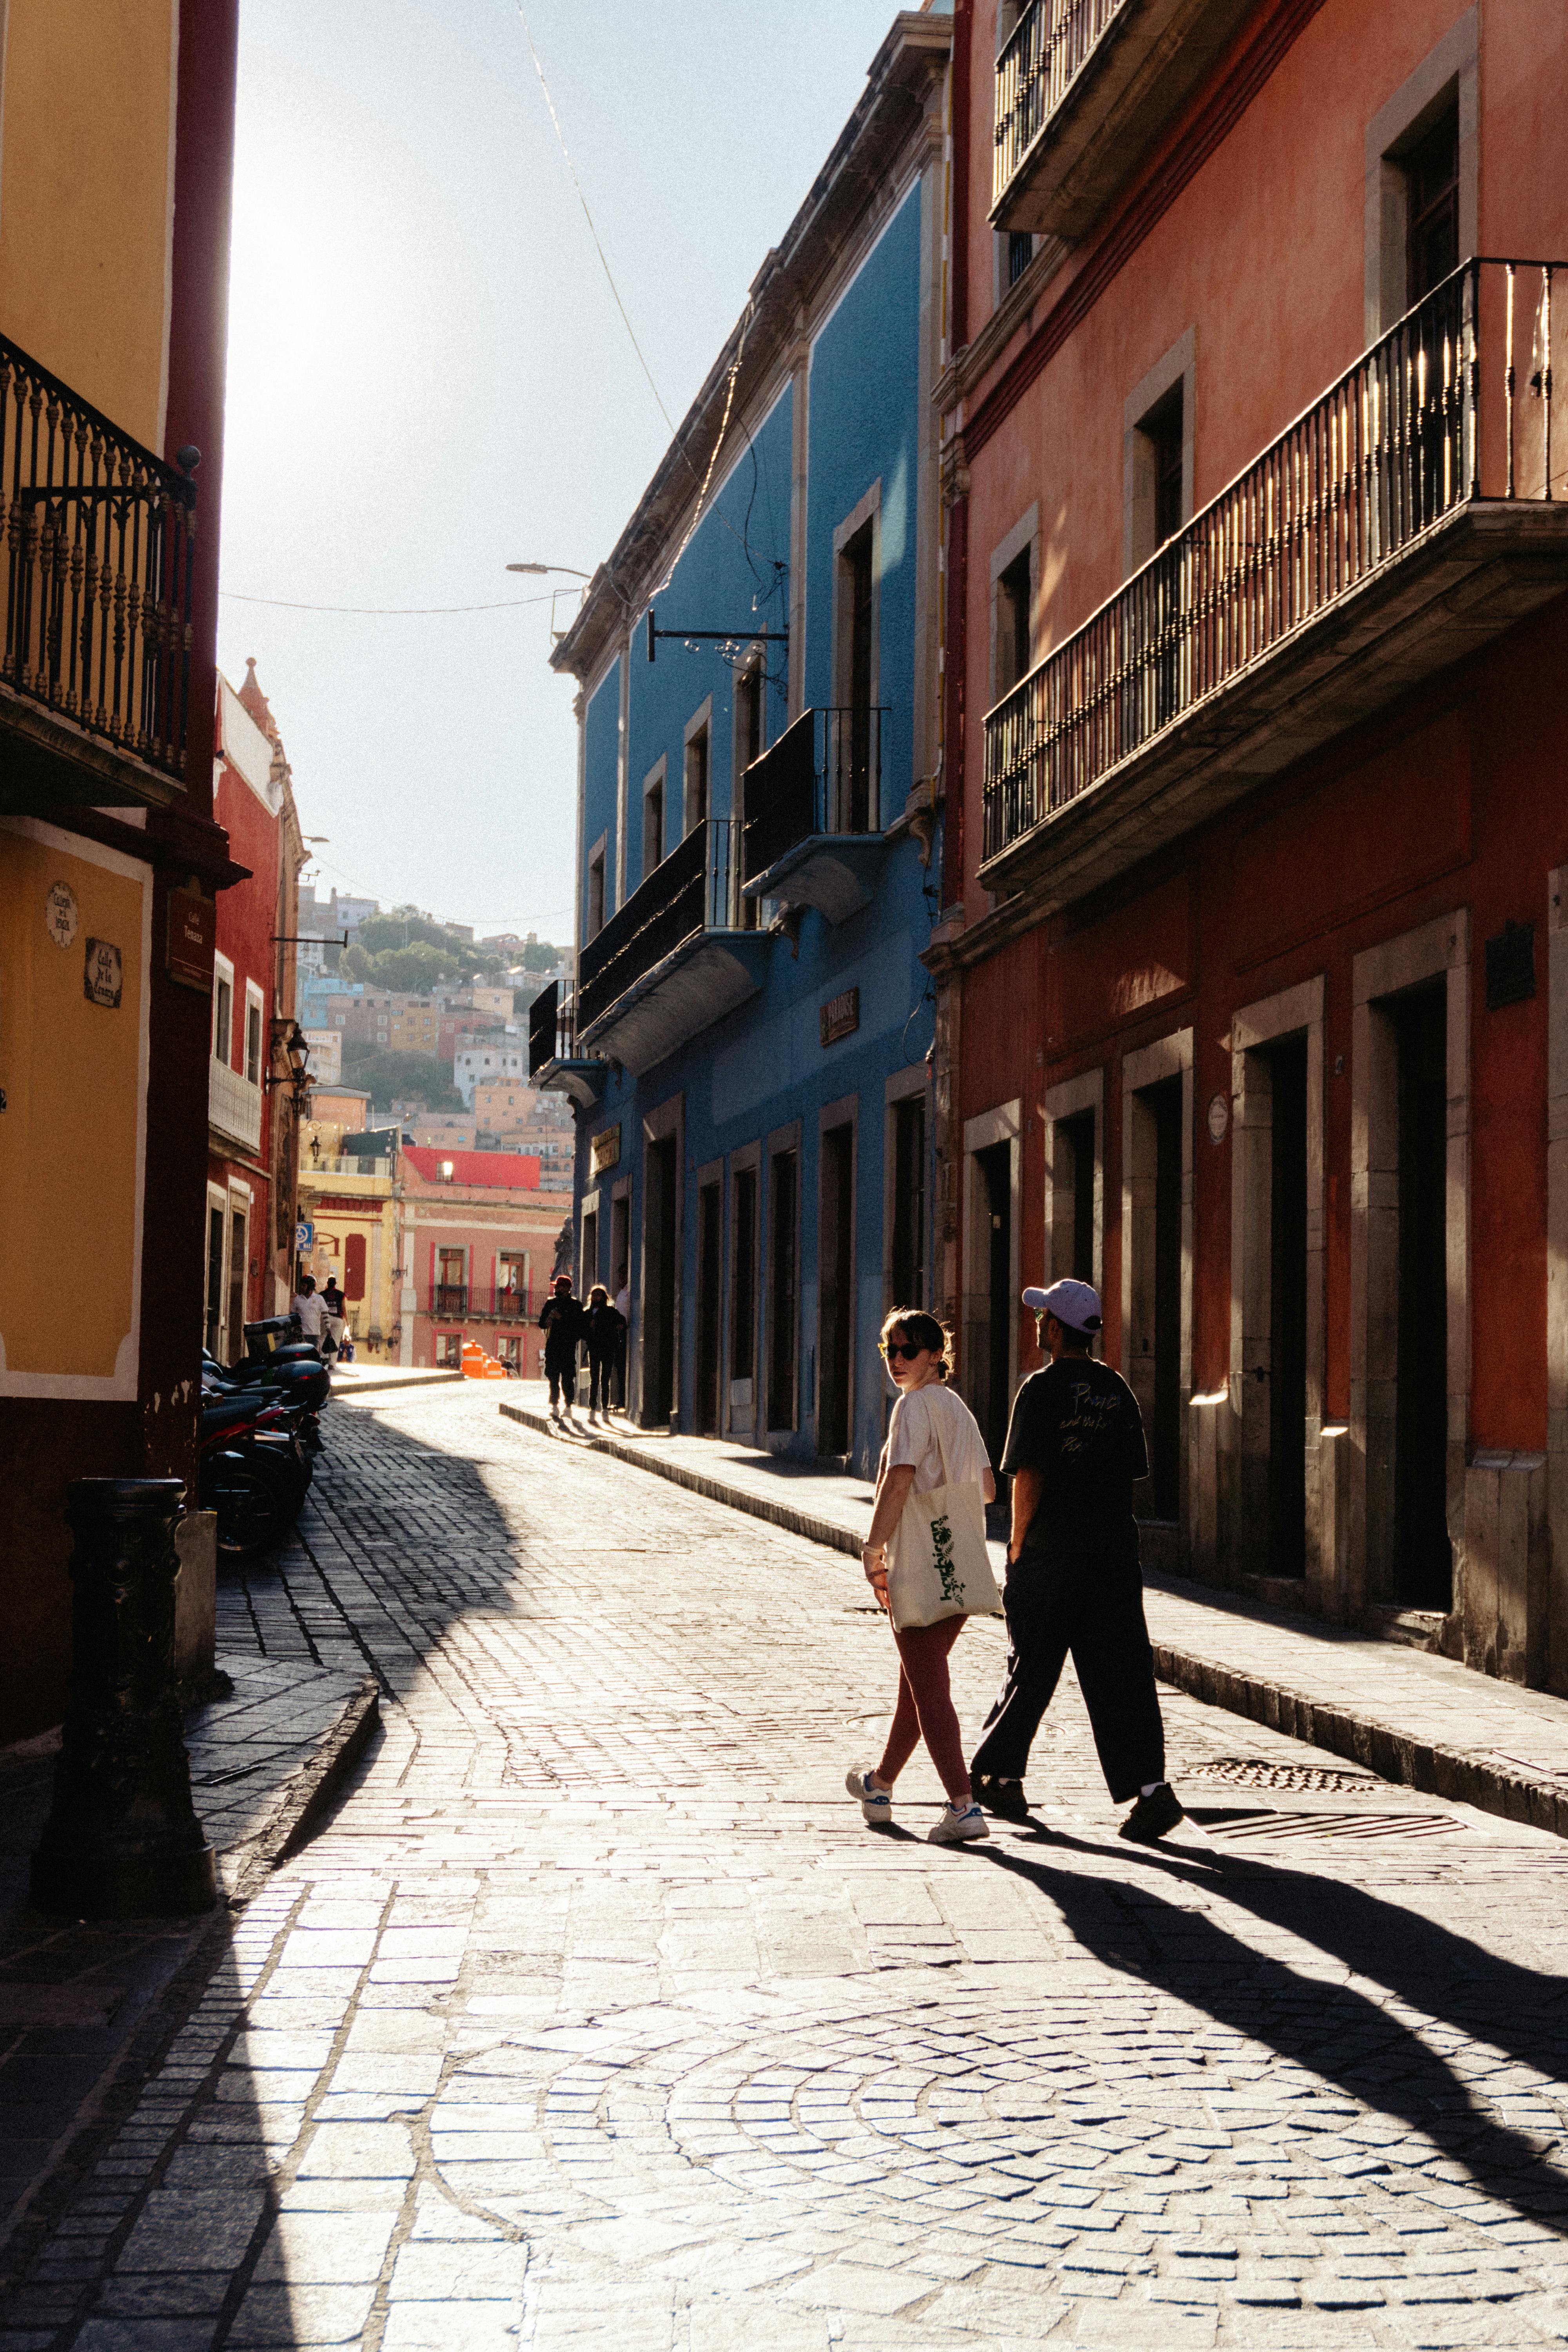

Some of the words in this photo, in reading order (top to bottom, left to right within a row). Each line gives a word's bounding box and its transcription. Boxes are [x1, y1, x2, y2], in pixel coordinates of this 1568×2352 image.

[189, 911, 200, 925] Calle
[184, 925, 203, 944] Tenaza
[98, 949, 112, 968] Calle
[105, 968, 112, 983] la
[931, 1520, 952, 1601] barbican
